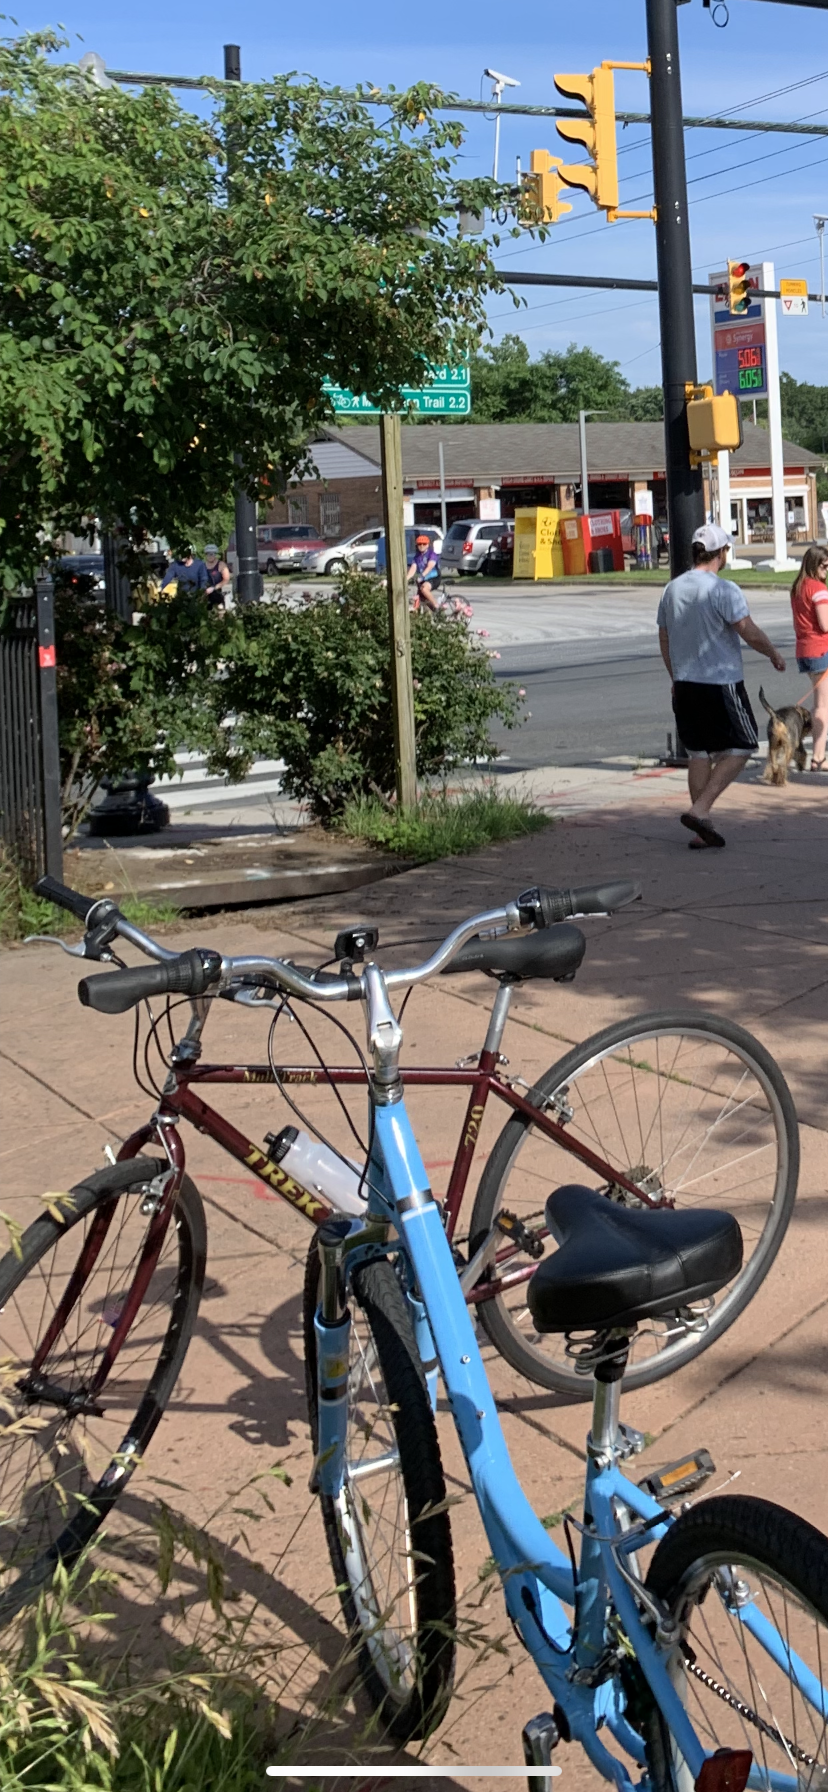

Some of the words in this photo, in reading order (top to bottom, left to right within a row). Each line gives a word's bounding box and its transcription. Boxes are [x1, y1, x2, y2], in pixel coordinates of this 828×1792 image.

[732, 333, 754, 344] Synergy
[450, 368, 466, 380] 2.1
[422, 396, 445, 409] Trail
[449, 397, 466, 409] 2.2
[464, 1104, 485, 1148] 720
[243, 1143, 324, 1219] TREK
